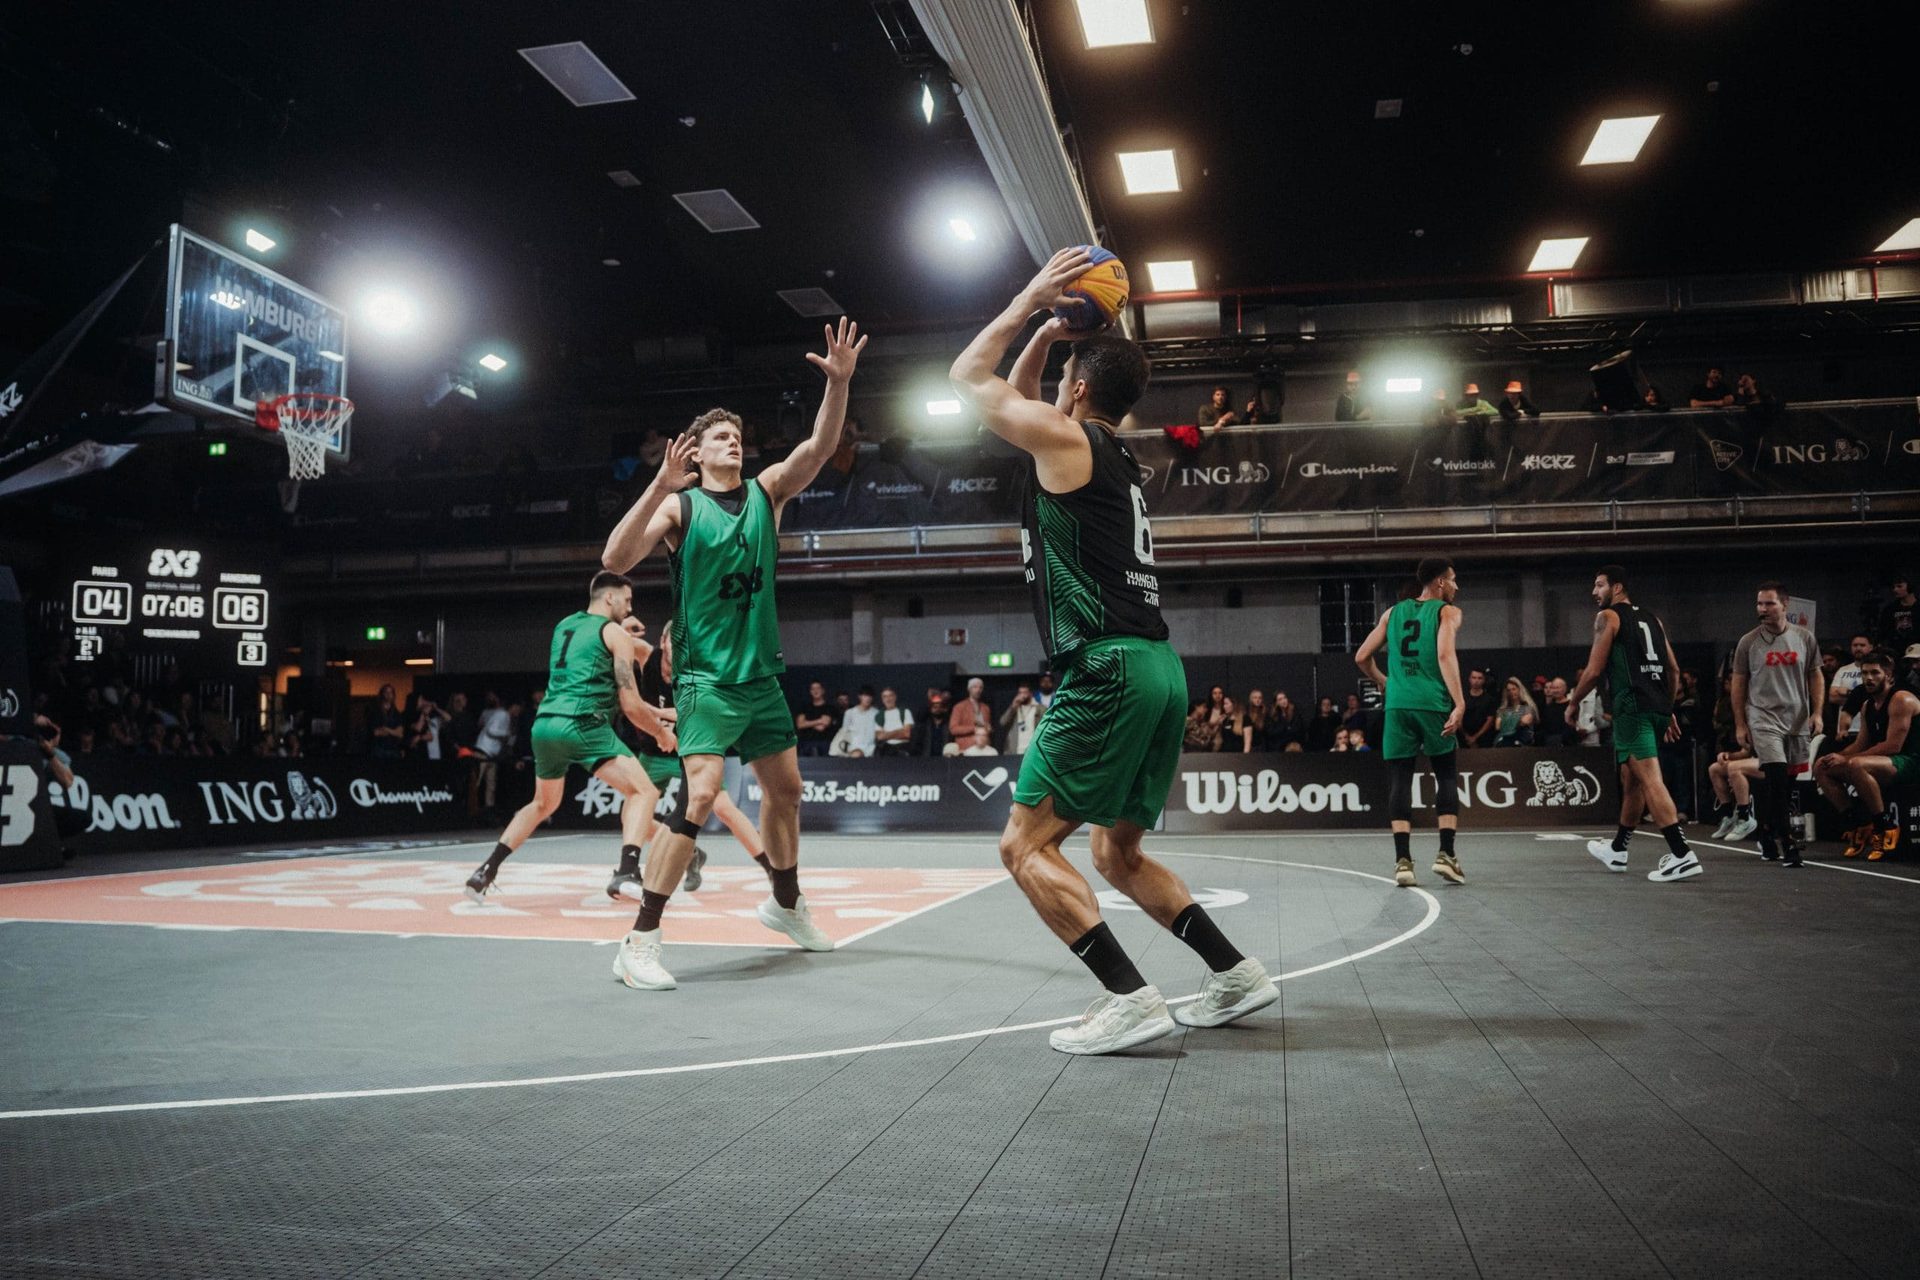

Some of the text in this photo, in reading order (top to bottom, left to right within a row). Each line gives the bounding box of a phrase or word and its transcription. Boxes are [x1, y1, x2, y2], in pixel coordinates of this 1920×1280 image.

[177, 379, 198, 396] ING
[1300, 461, 1397, 480] Champion
[1774, 445, 1826, 464] ING
[1181, 467, 1231, 487] ING
[1130, 482, 1156, 566] 6
[83, 587, 123, 617] 04
[142, 593, 205, 618] 07:06
[222, 594, 260, 622] 06
[554, 629, 576, 669] 1
[1401, 620, 1421, 657] 2
[1638, 621, 1659, 661] 1
[48, 775, 182, 833] ilson.
[198, 781, 285, 824] ING
[349, 778, 453, 813] Champion
